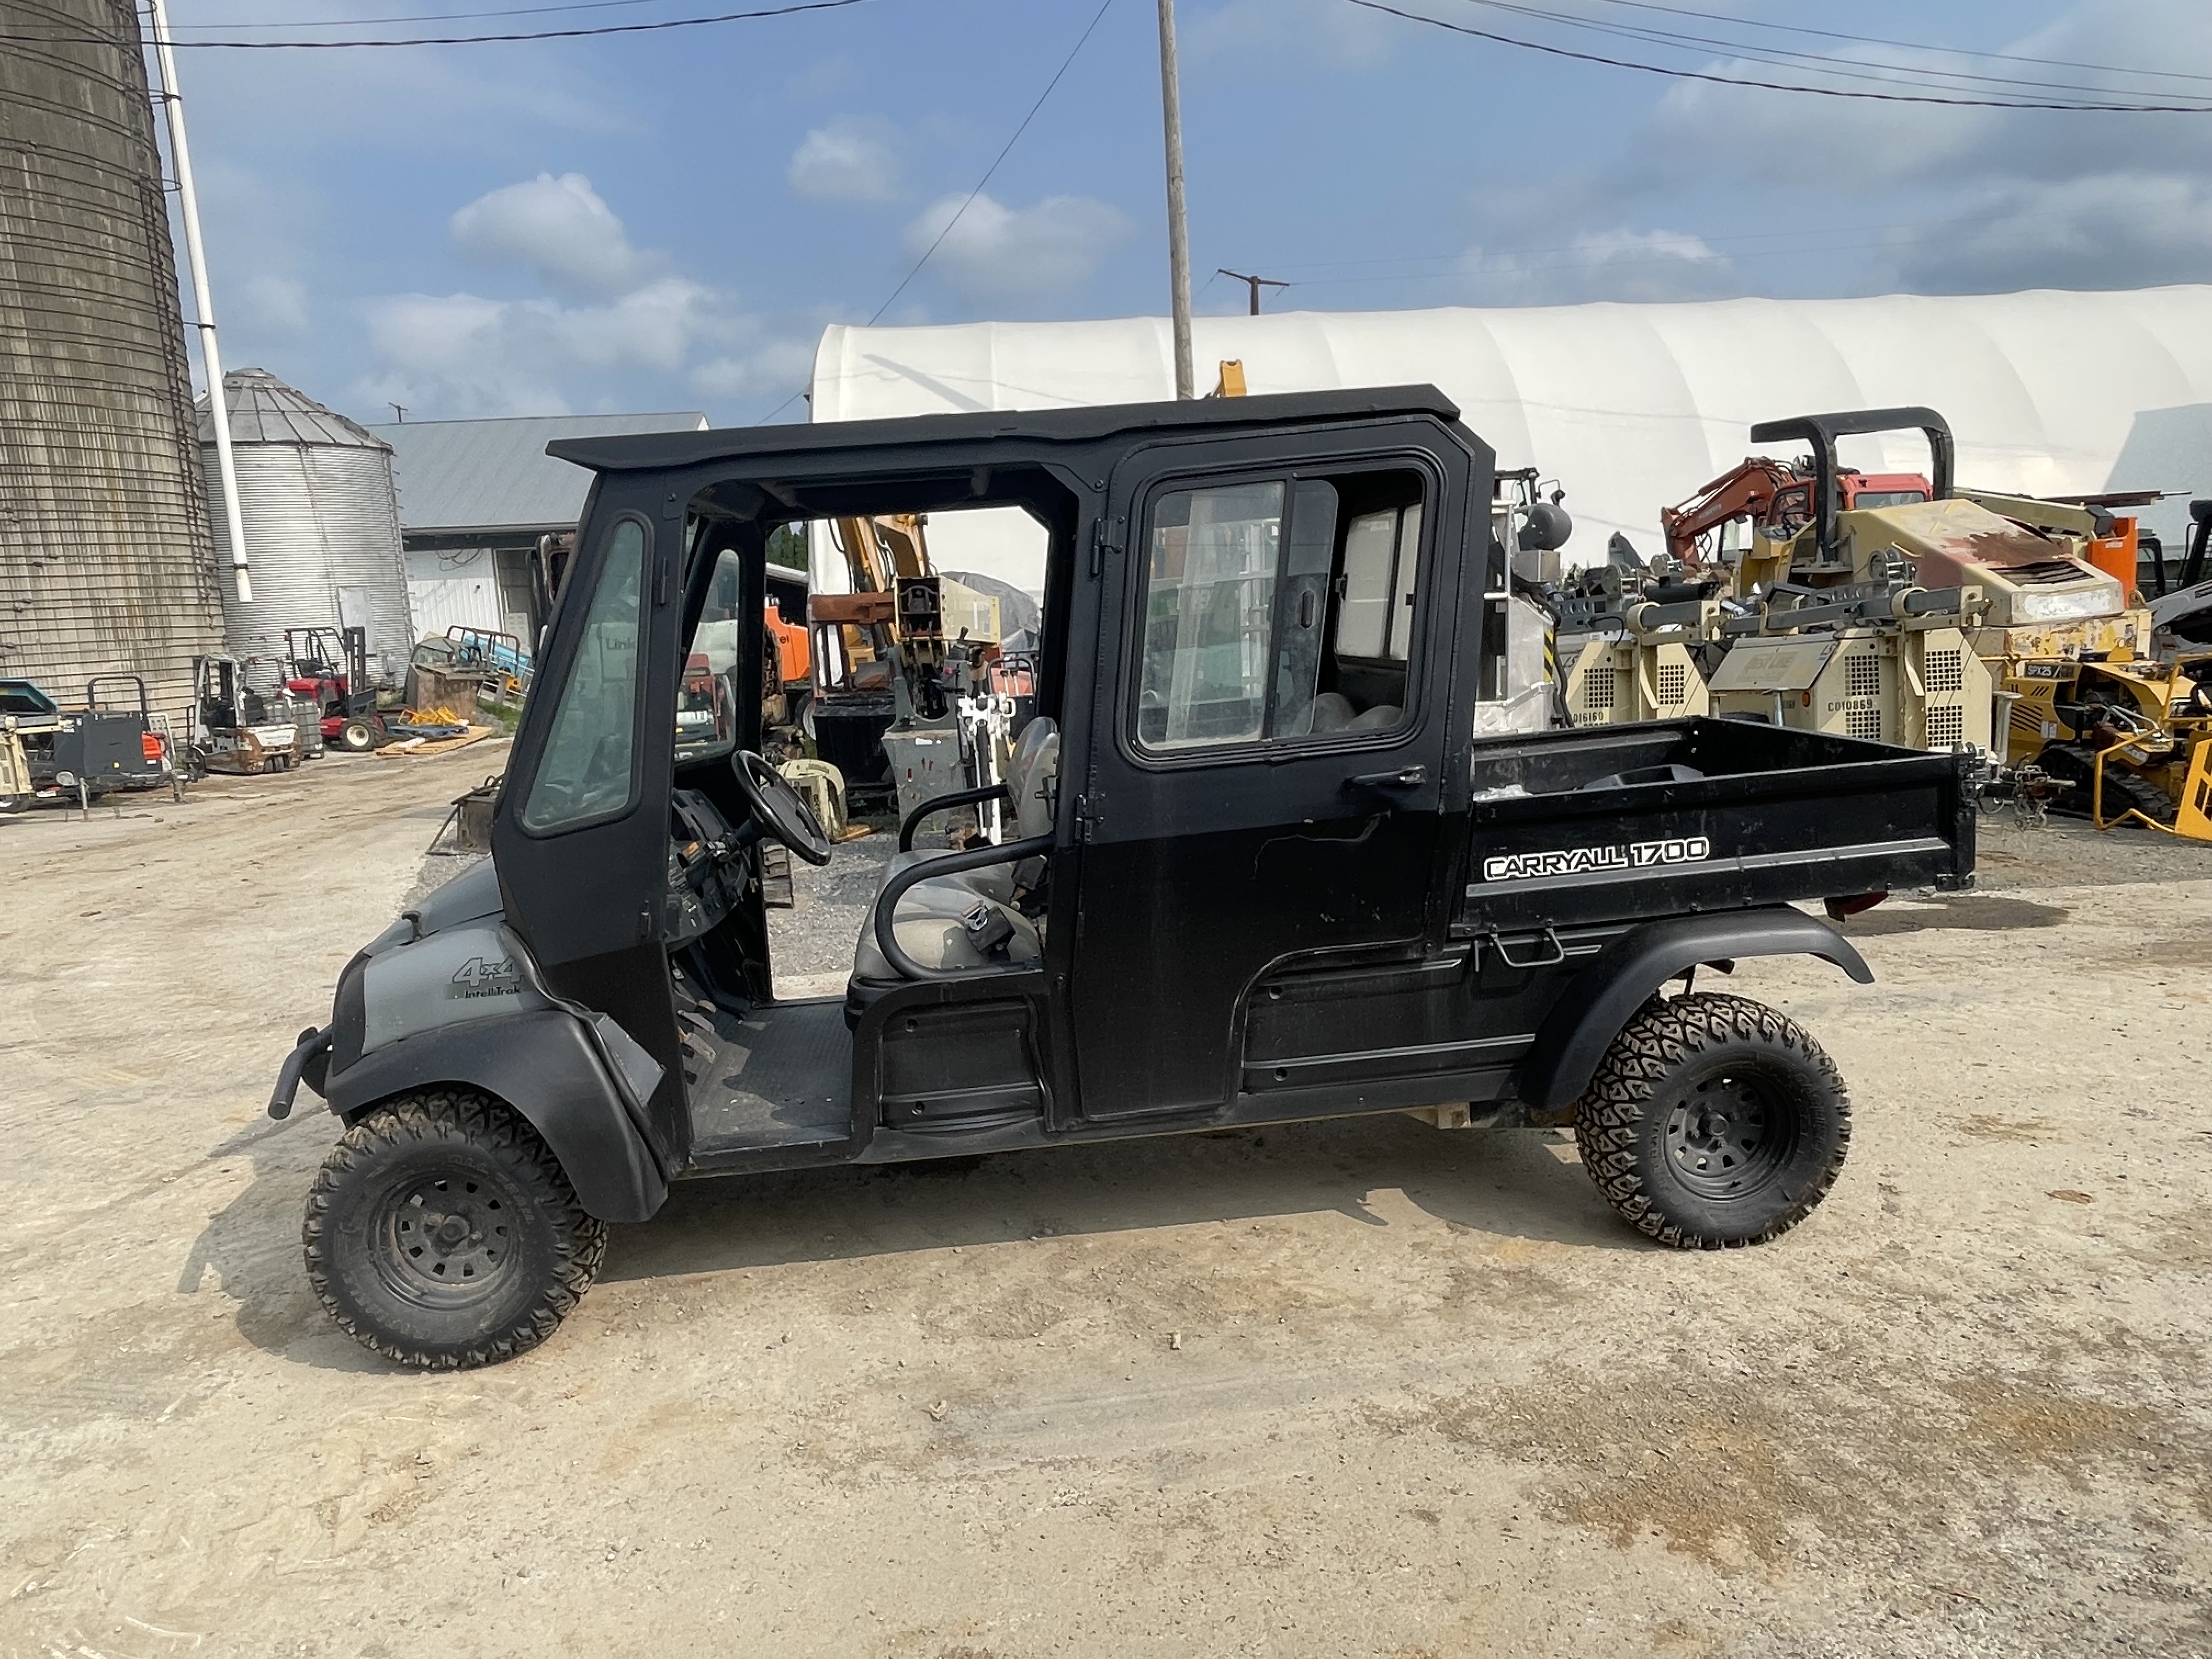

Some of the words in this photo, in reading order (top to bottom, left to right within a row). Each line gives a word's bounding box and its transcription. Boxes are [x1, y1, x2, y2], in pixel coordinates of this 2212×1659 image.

[1484, 845, 1628, 881] CARRYALL
[1630, 837, 1709, 867] 1700
[453, 955, 524, 988] 4x4
[465, 985, 521, 1000] IntelliTrak
